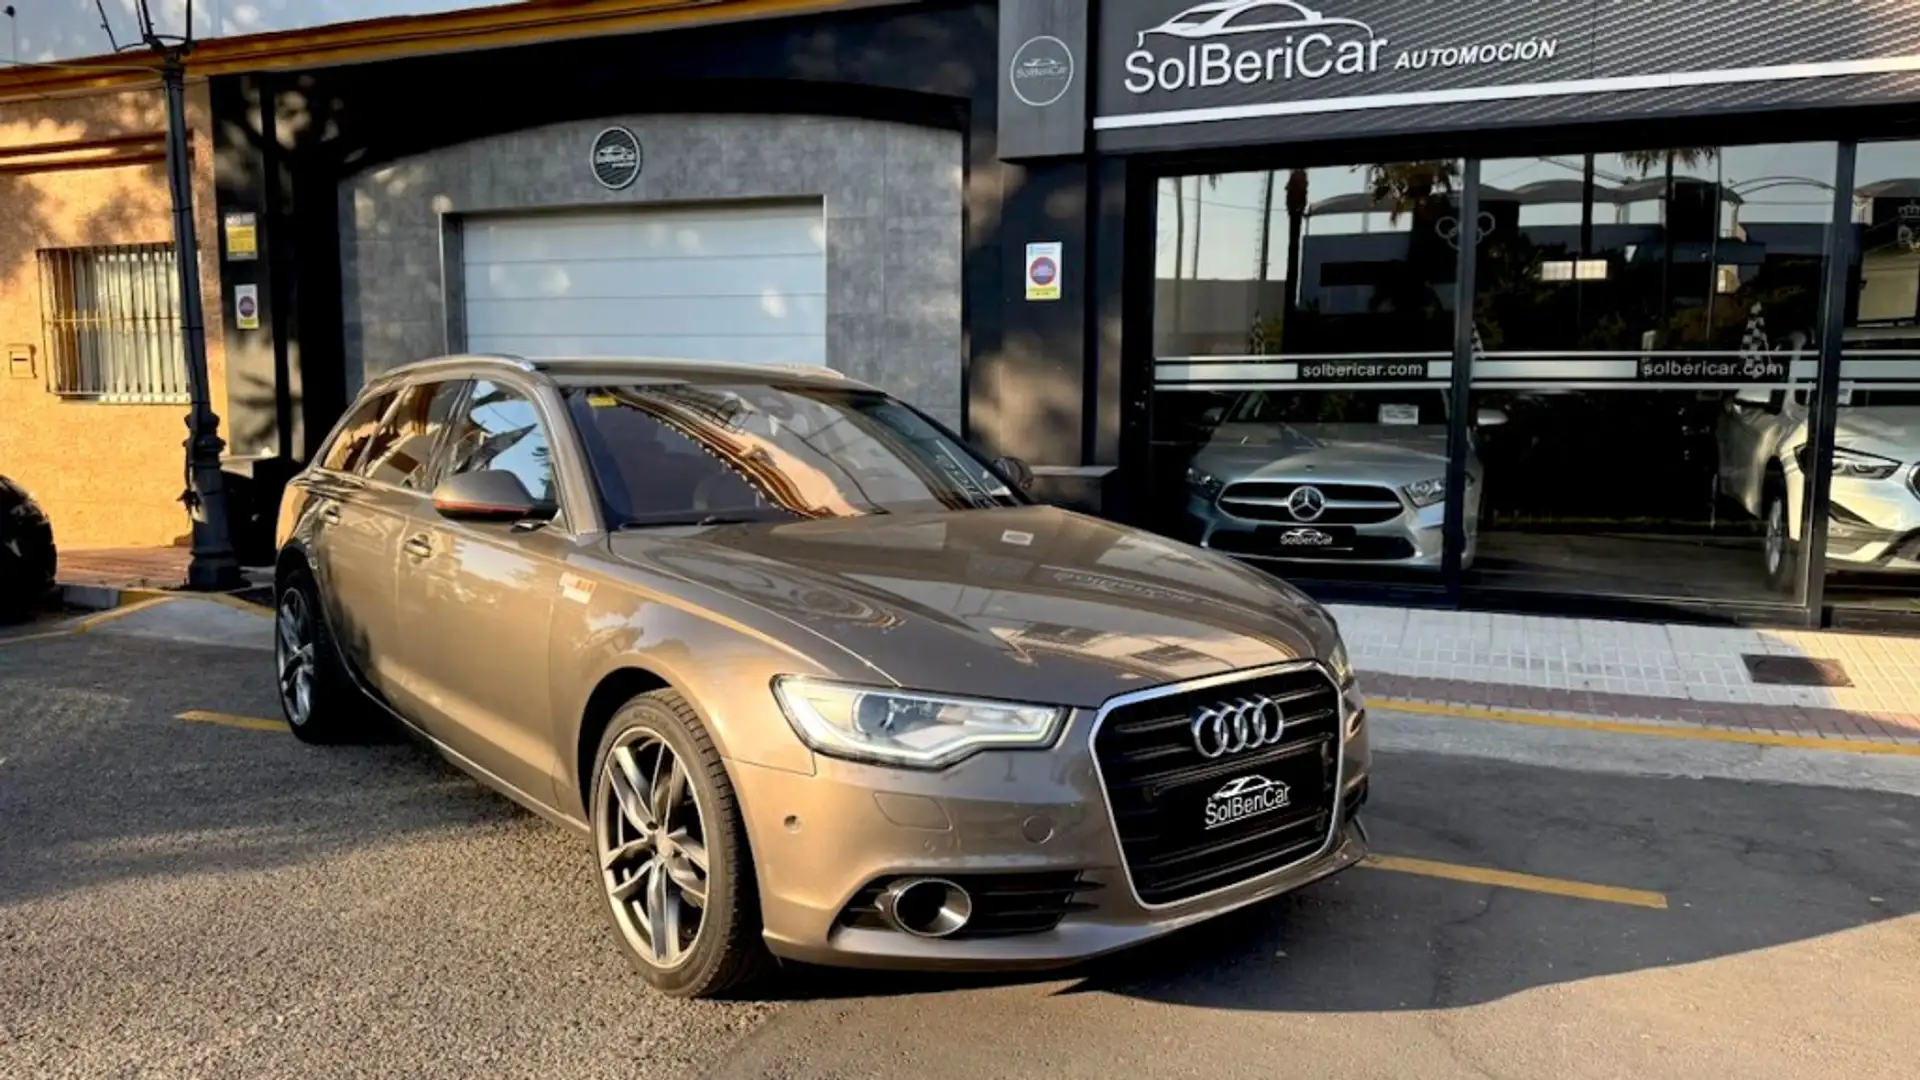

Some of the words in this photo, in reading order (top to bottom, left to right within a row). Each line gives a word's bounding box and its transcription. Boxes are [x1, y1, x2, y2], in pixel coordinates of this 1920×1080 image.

[1124, 32, 1388, 94] SolBeriCar
[1394, 36, 1557, 70] AUTOMOCIÓN
[1303, 362, 1423, 377] solbericar.com
[1643, 360, 1783, 377] solbericar.com
